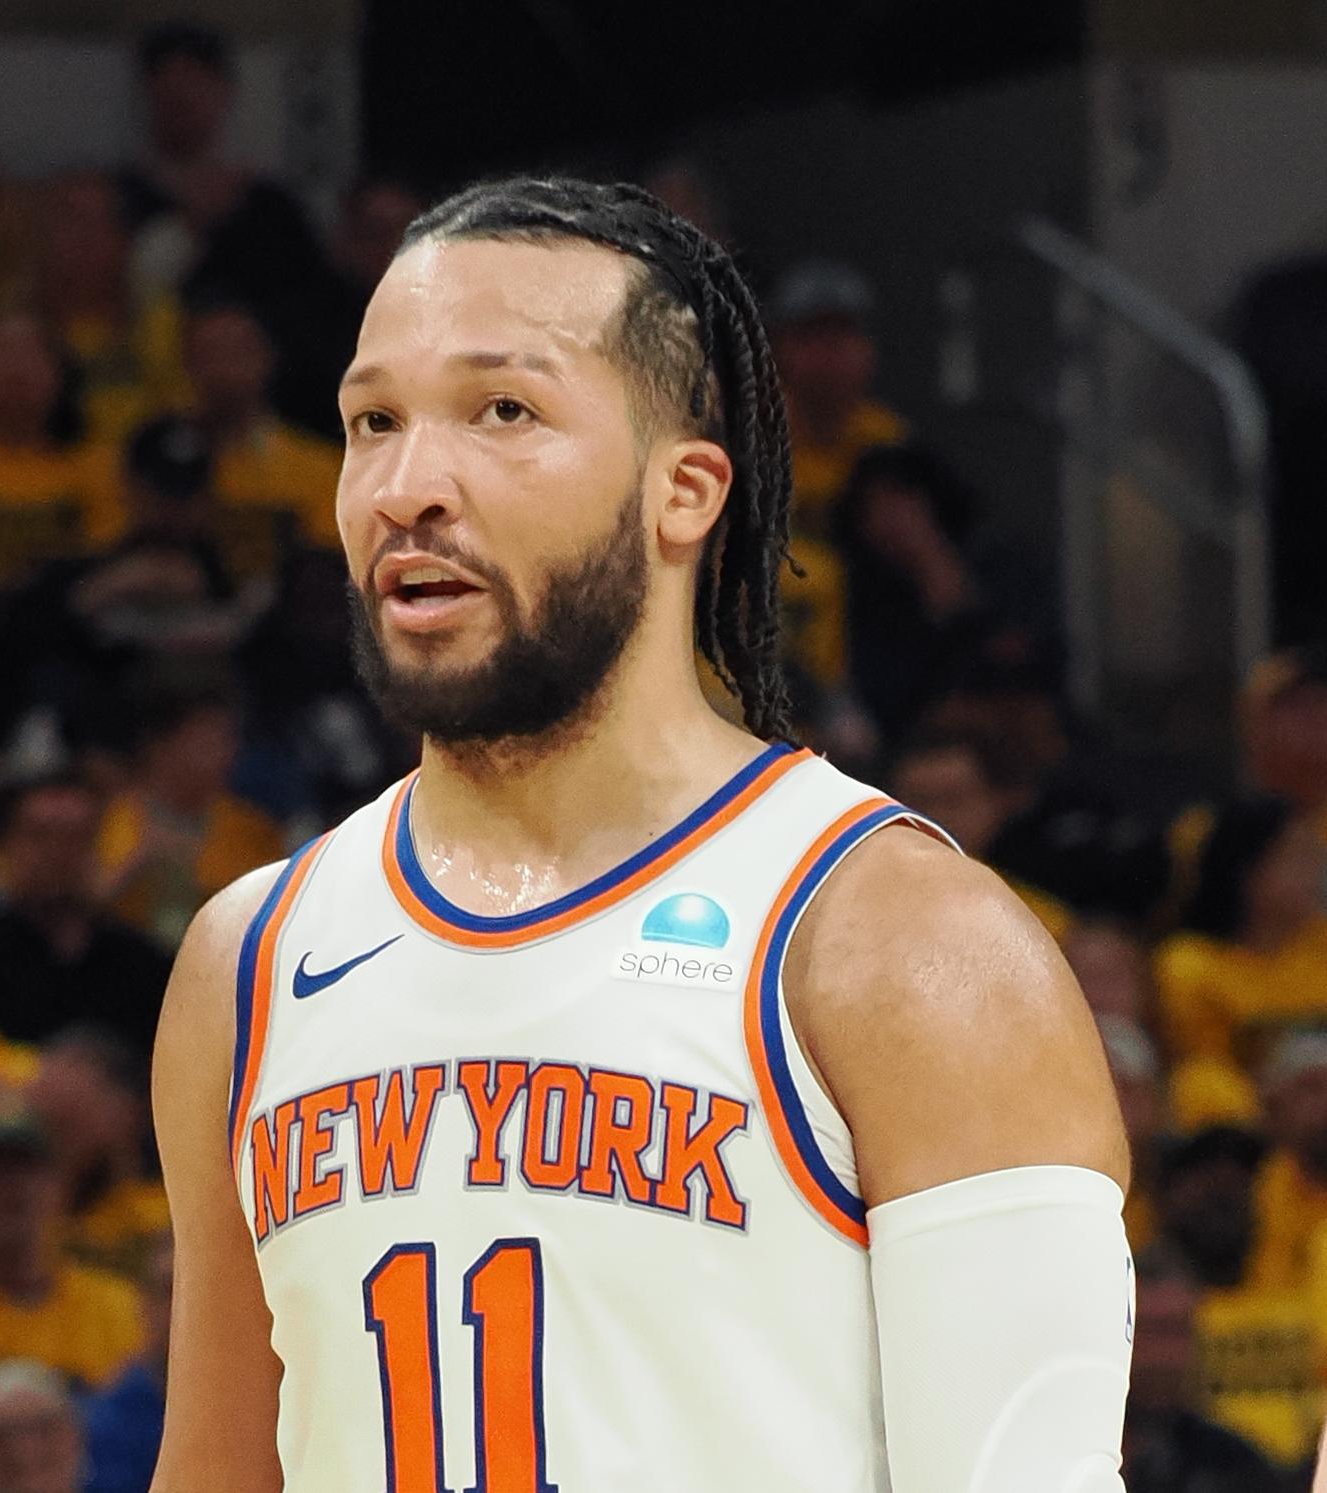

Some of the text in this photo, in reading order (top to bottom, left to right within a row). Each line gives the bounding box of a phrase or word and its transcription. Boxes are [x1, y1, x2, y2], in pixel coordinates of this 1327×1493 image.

[619, 951, 734, 983] sphere
[251, 1057, 750, 1251] NEW YORK
[361, 1237, 558, 1493] 11
